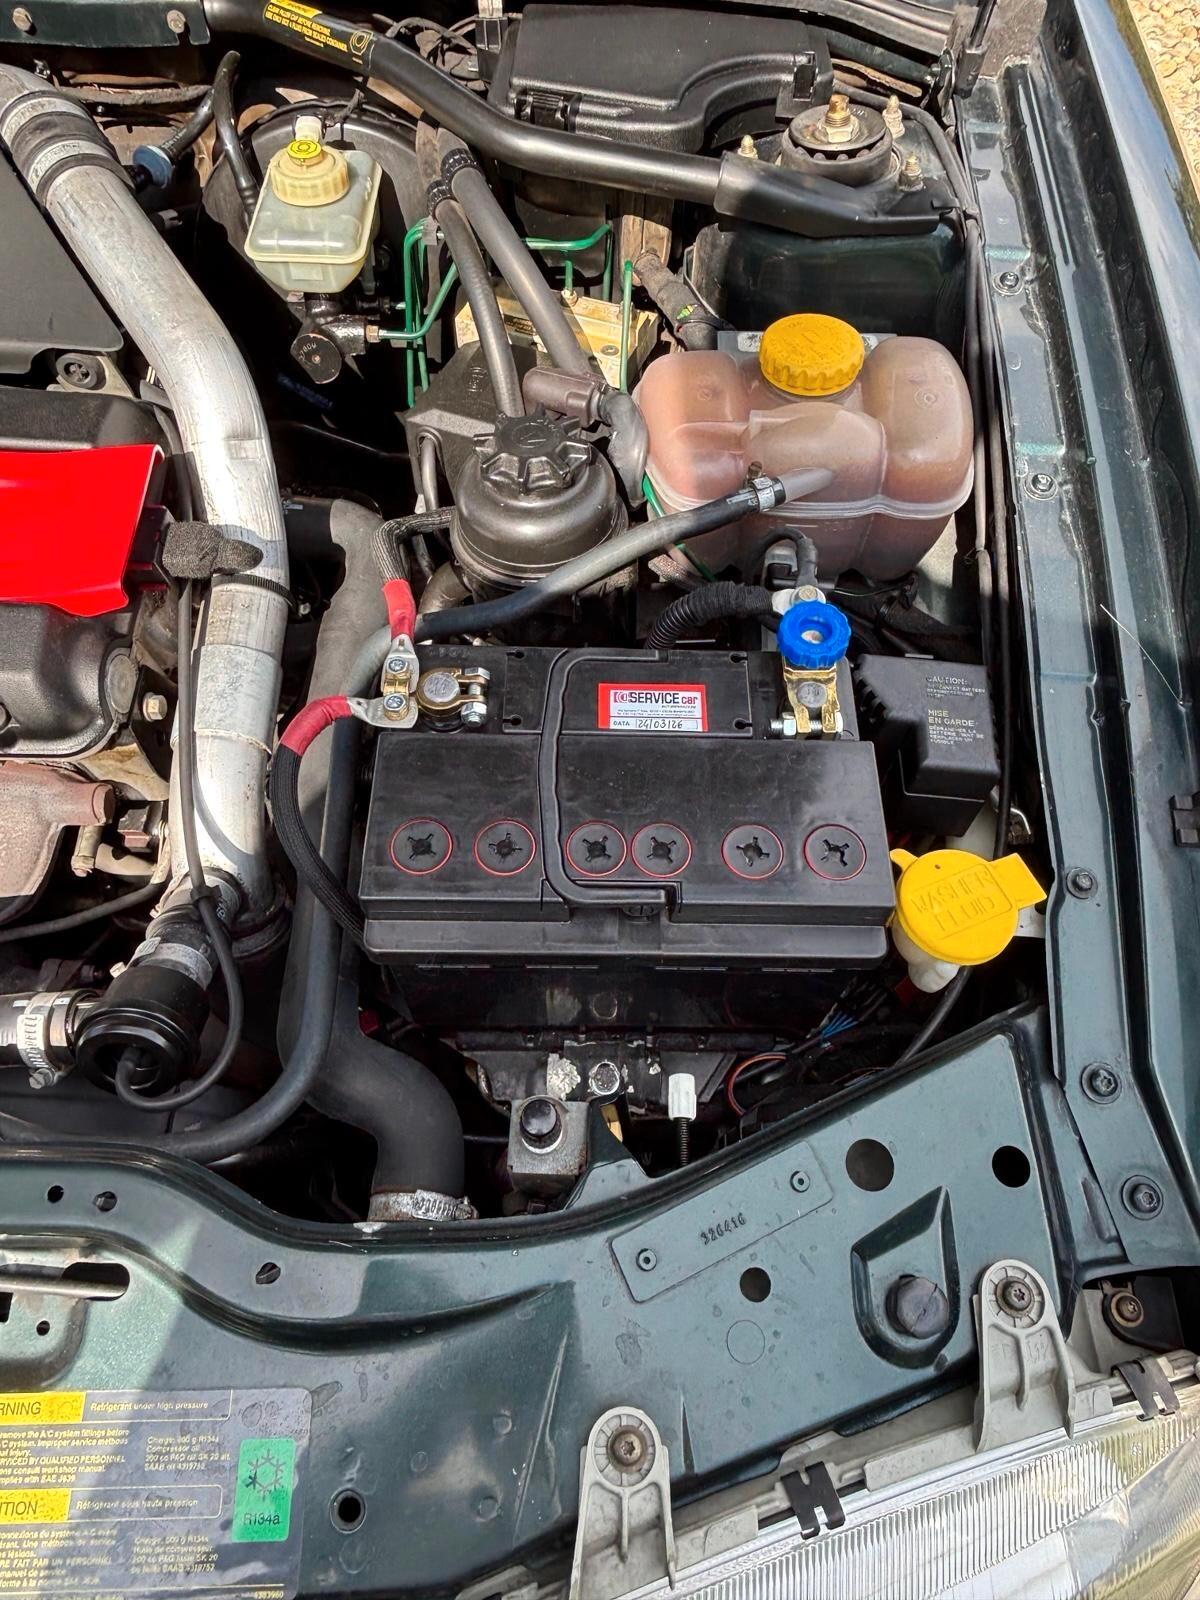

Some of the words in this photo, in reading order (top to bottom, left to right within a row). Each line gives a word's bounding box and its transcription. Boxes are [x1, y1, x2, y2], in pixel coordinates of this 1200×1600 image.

[629, 692, 679, 704] SERVICE
[681, 696, 698, 705] car
[928, 709, 949, 717] MISE
[928, 716, 942, 724] EN
[911, 869, 995, 914] WASHER
[934, 895, 996, 932] FLUID
[91, 1402, 132, 1413] Refrigerant
[175, 1401, 208, 1410] pressure
[243, 1513, 281, 1526] R134a
